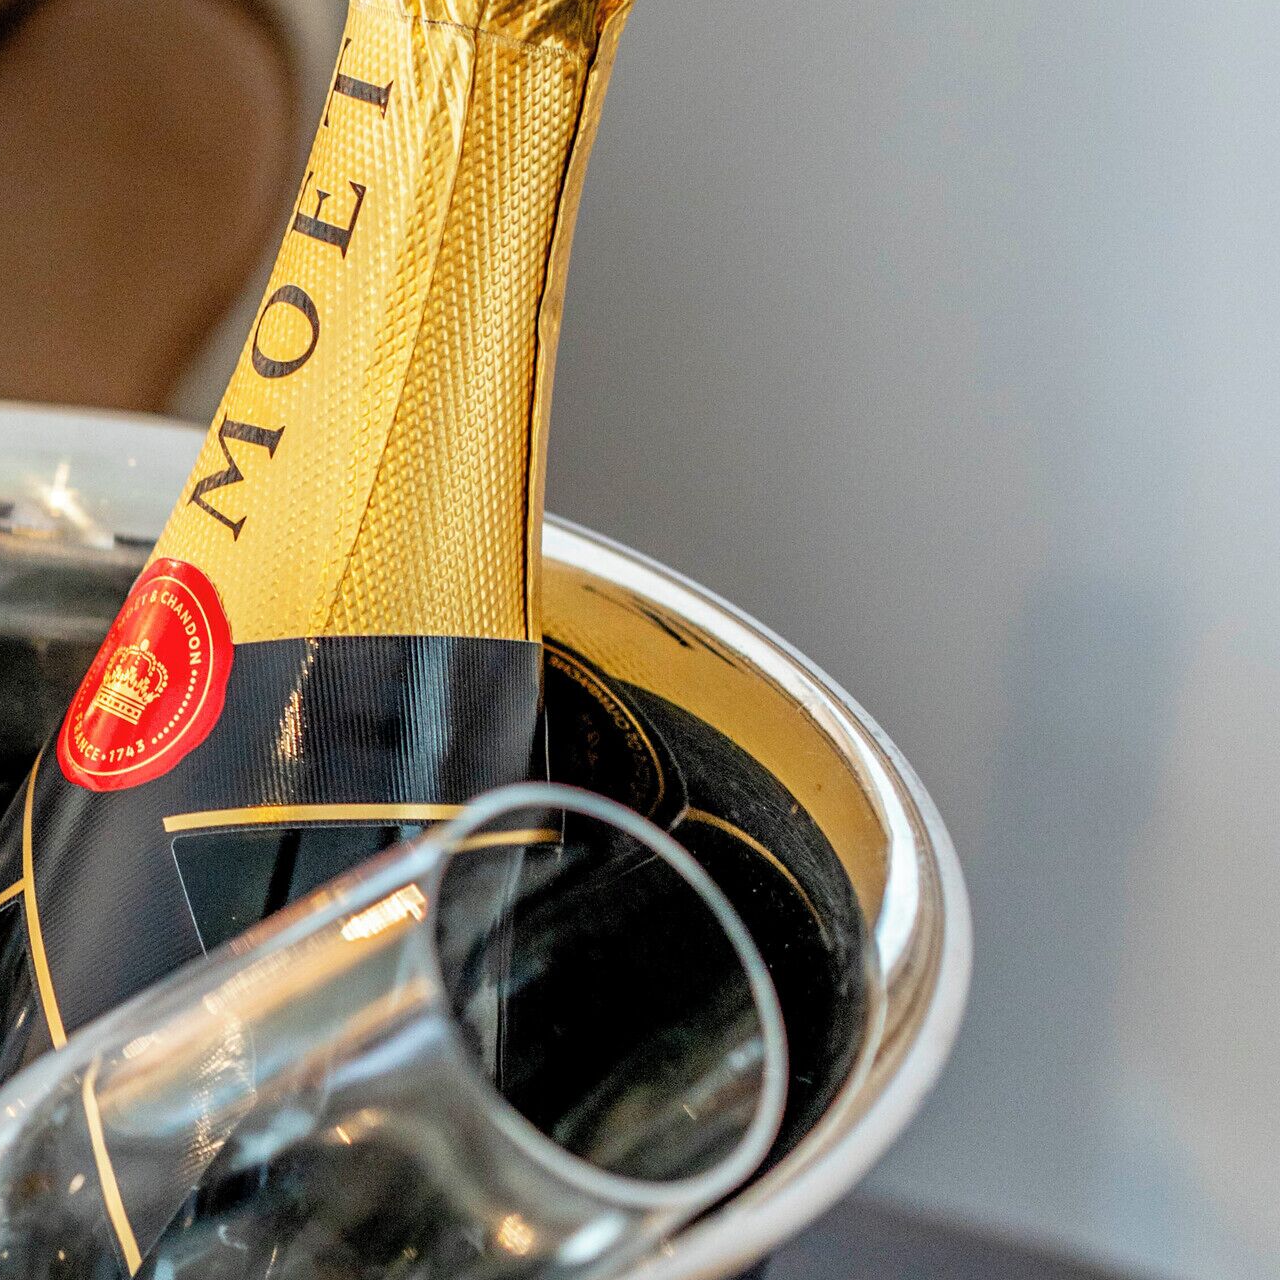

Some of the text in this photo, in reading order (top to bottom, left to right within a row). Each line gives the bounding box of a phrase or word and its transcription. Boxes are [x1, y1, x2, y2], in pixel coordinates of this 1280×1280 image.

[149, 589, 158, 604] &
[160, 590, 202, 666] CHANDON
[109, 738, 146, 763] 1743
